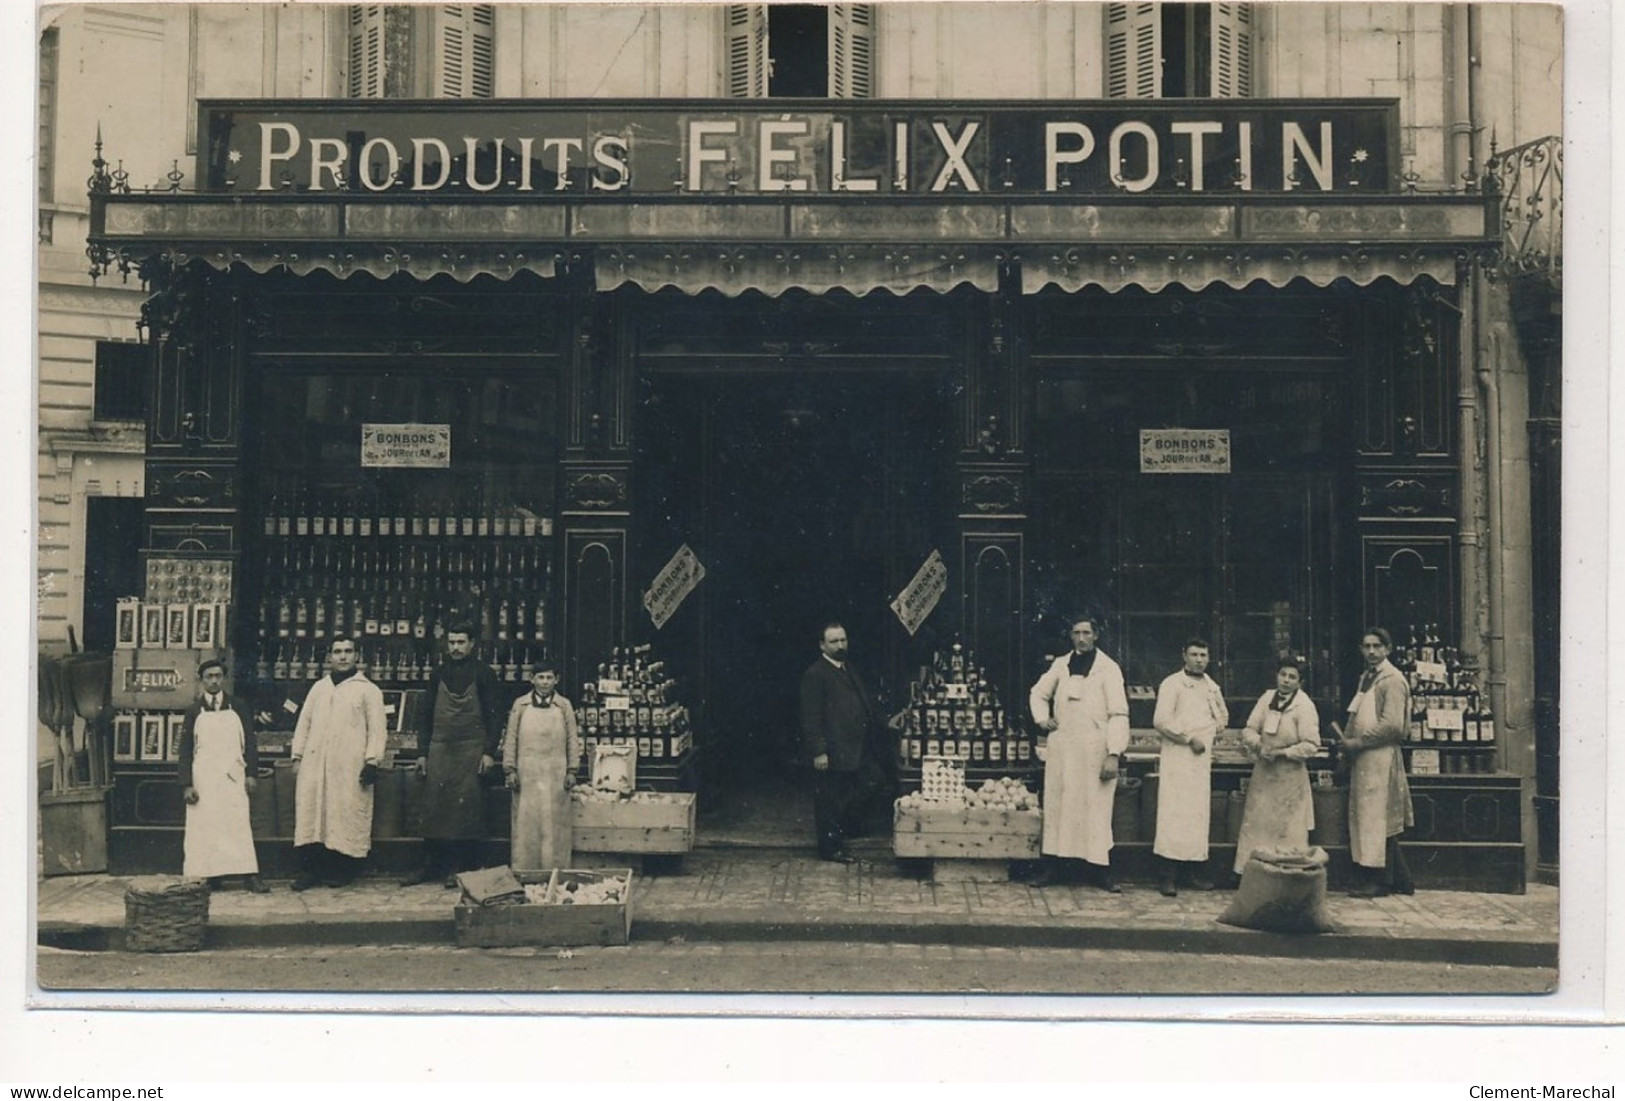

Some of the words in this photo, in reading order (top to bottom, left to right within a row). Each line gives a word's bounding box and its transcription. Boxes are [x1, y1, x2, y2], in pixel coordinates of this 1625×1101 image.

[257, 121, 630, 192] PRODUITS
[687, 112, 981, 192] FÉLIX
[1045, 121, 1333, 192] POTIN
[376, 433, 436, 444] BONBONS
[1154, 439, 1216, 450] BONBONS
[380, 449, 406, 458] JOUR
[1160, 454, 1184, 464] JOUR
